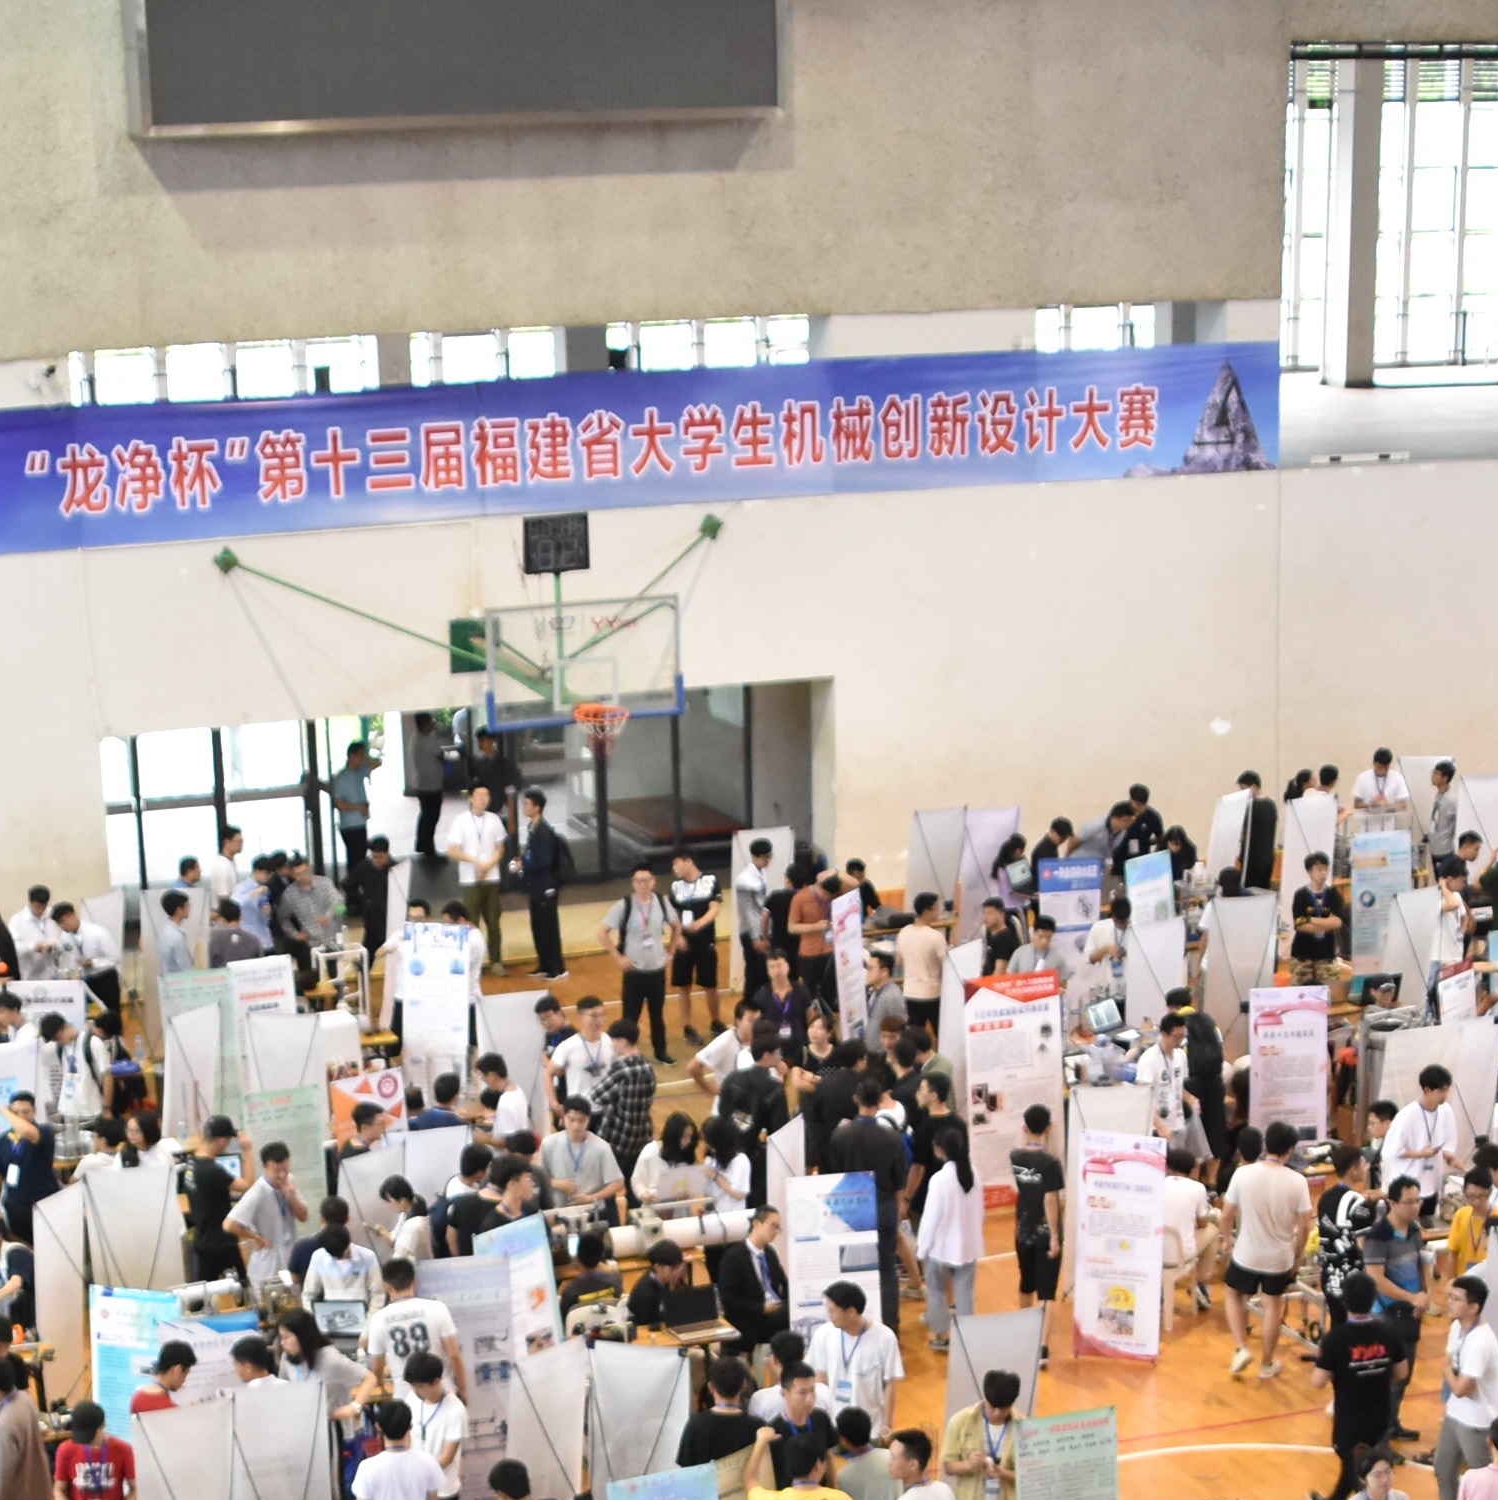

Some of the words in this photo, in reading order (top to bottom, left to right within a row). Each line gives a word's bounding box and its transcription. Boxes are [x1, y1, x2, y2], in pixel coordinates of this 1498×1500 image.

[24, 384, 1160, 517] “龙净杯”第十三届福建省大学生机械创新设计大赛
[388, 1321, 431, 1359] 89
